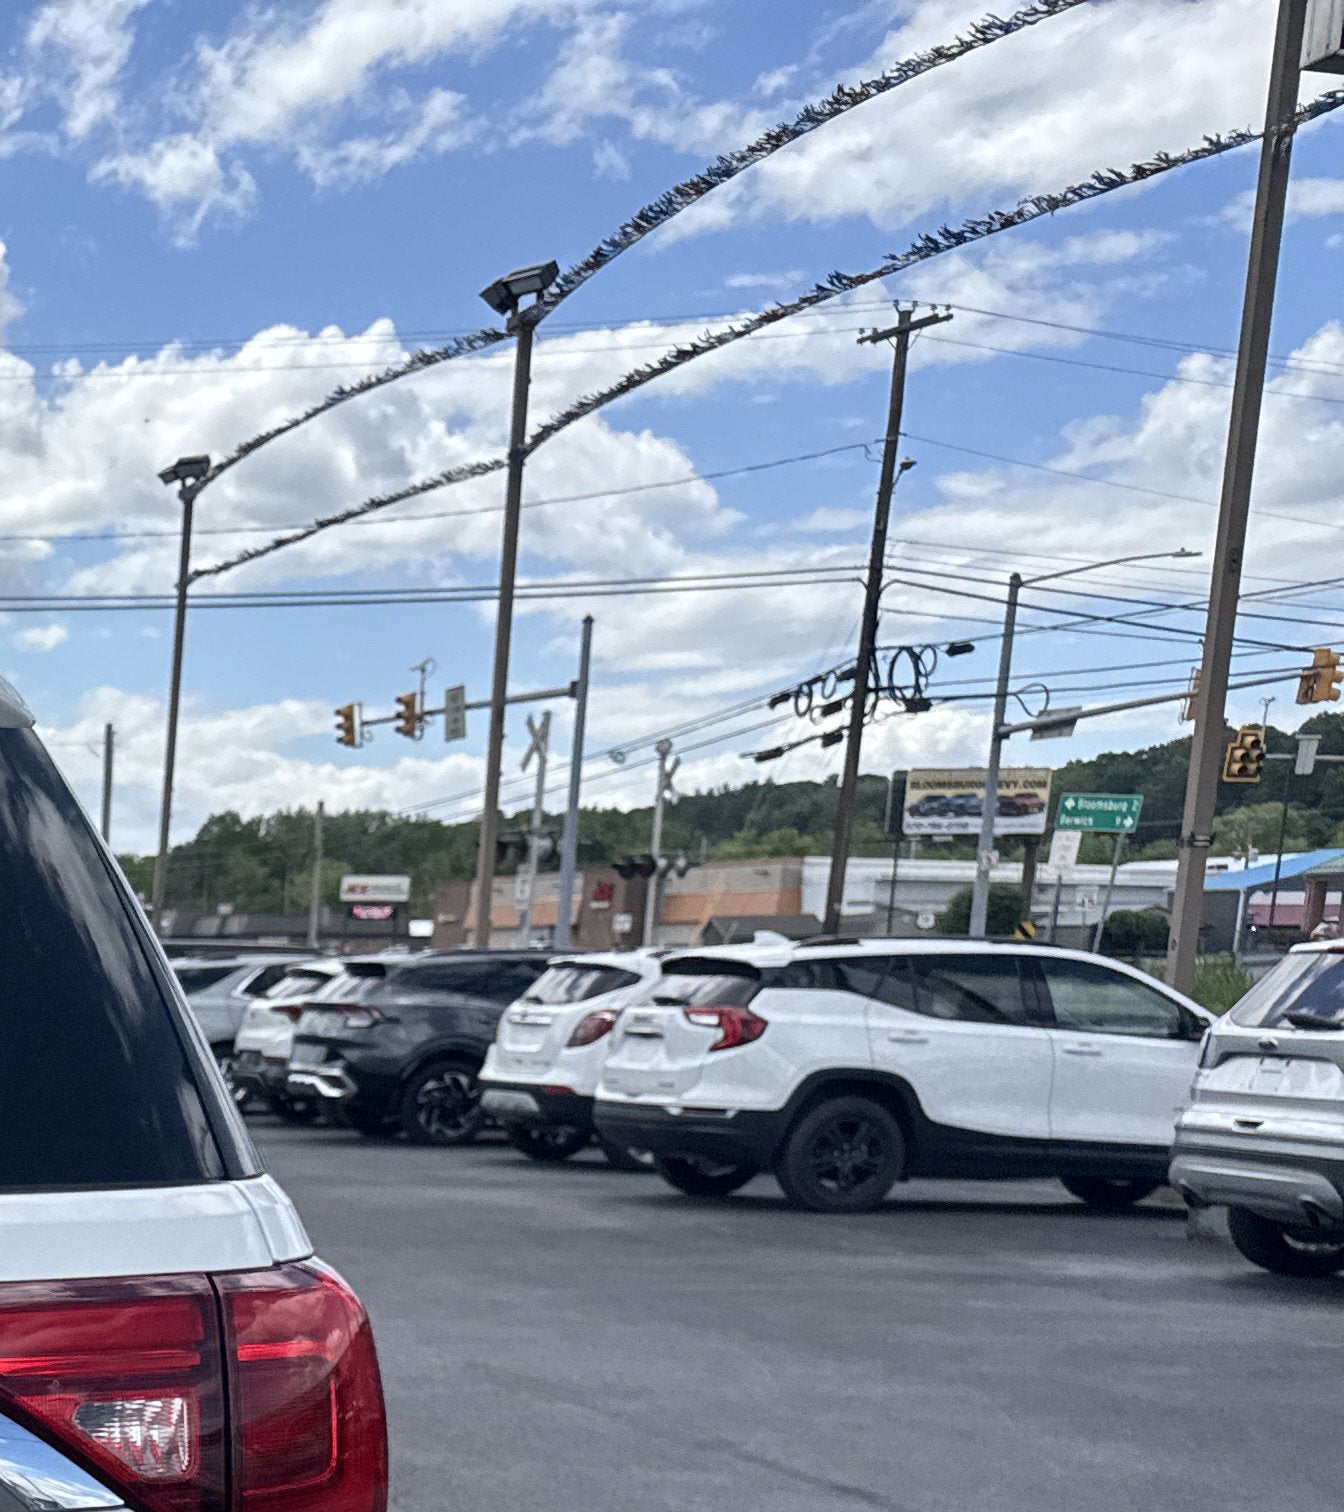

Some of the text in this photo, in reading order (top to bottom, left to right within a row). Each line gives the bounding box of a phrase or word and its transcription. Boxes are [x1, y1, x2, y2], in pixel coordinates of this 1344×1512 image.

[909, 779, 1048, 790] BLOOMSBURGEVY.COM
[1077, 798, 1129, 812] Bloomsburg
[1059, 814, 1094, 826] Berwick
